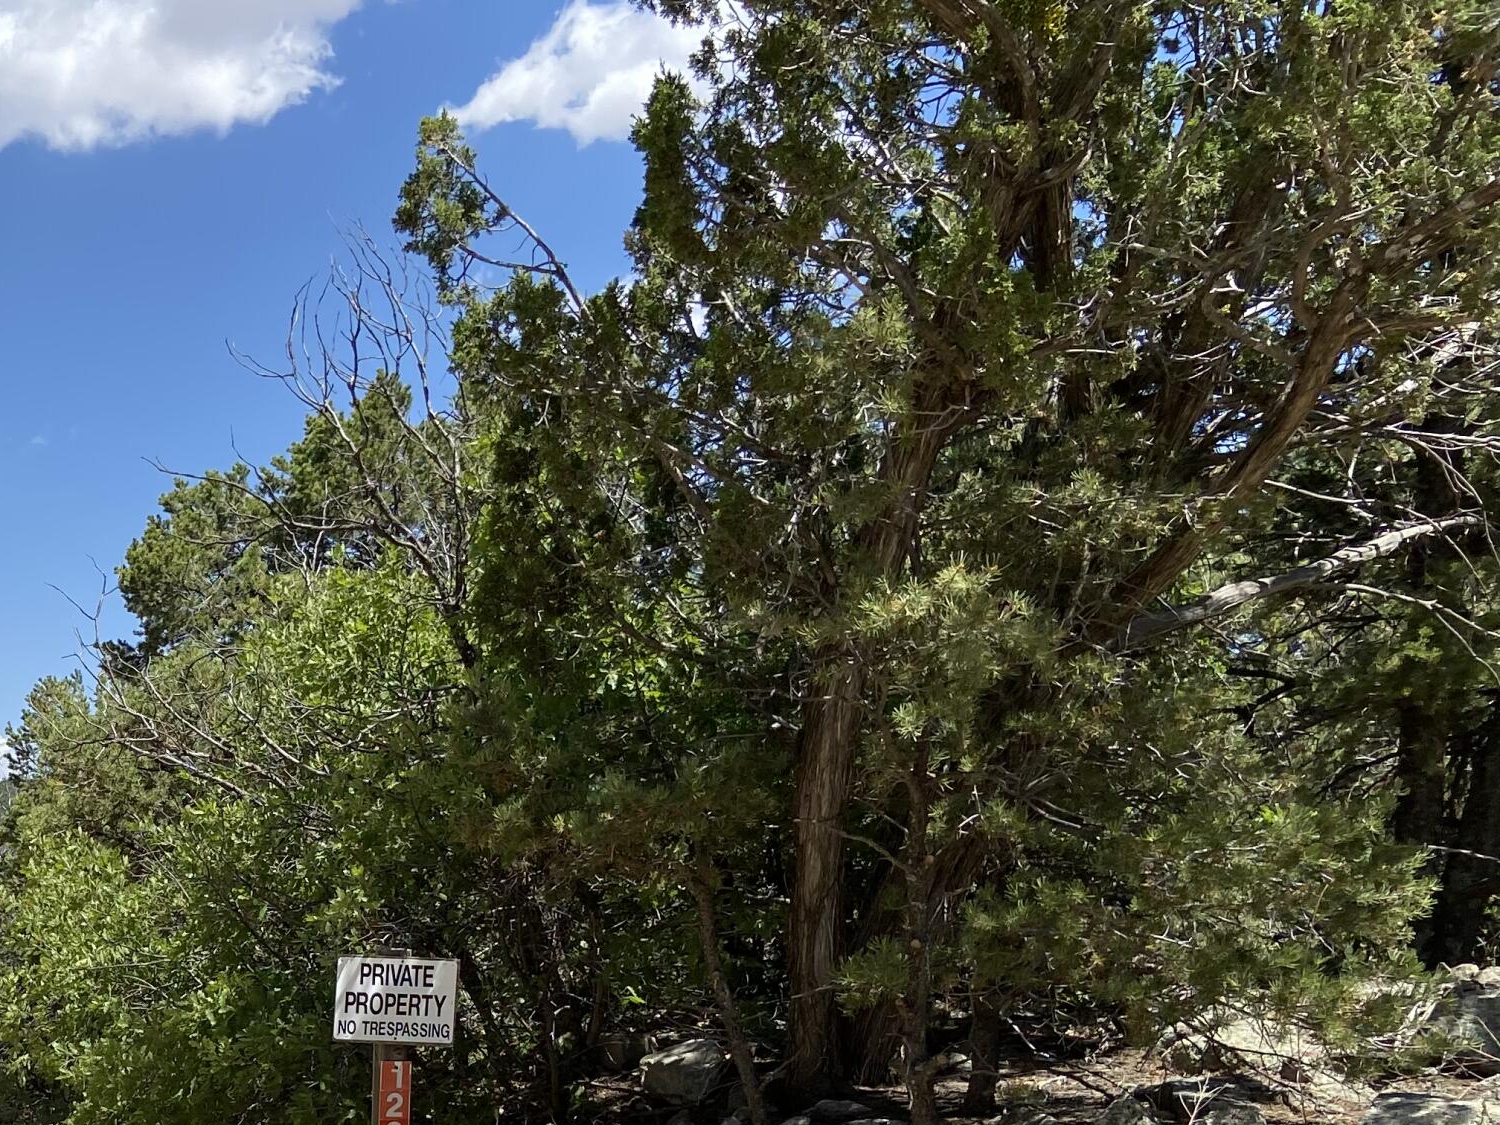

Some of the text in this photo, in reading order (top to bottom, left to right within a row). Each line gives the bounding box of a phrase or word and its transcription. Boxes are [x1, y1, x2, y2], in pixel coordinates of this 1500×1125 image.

[360, 963, 435, 987] PRIVATE
[344, 992, 447, 1017] PROPERTY
[337, 1020, 450, 1039] NO TRESPASSING
